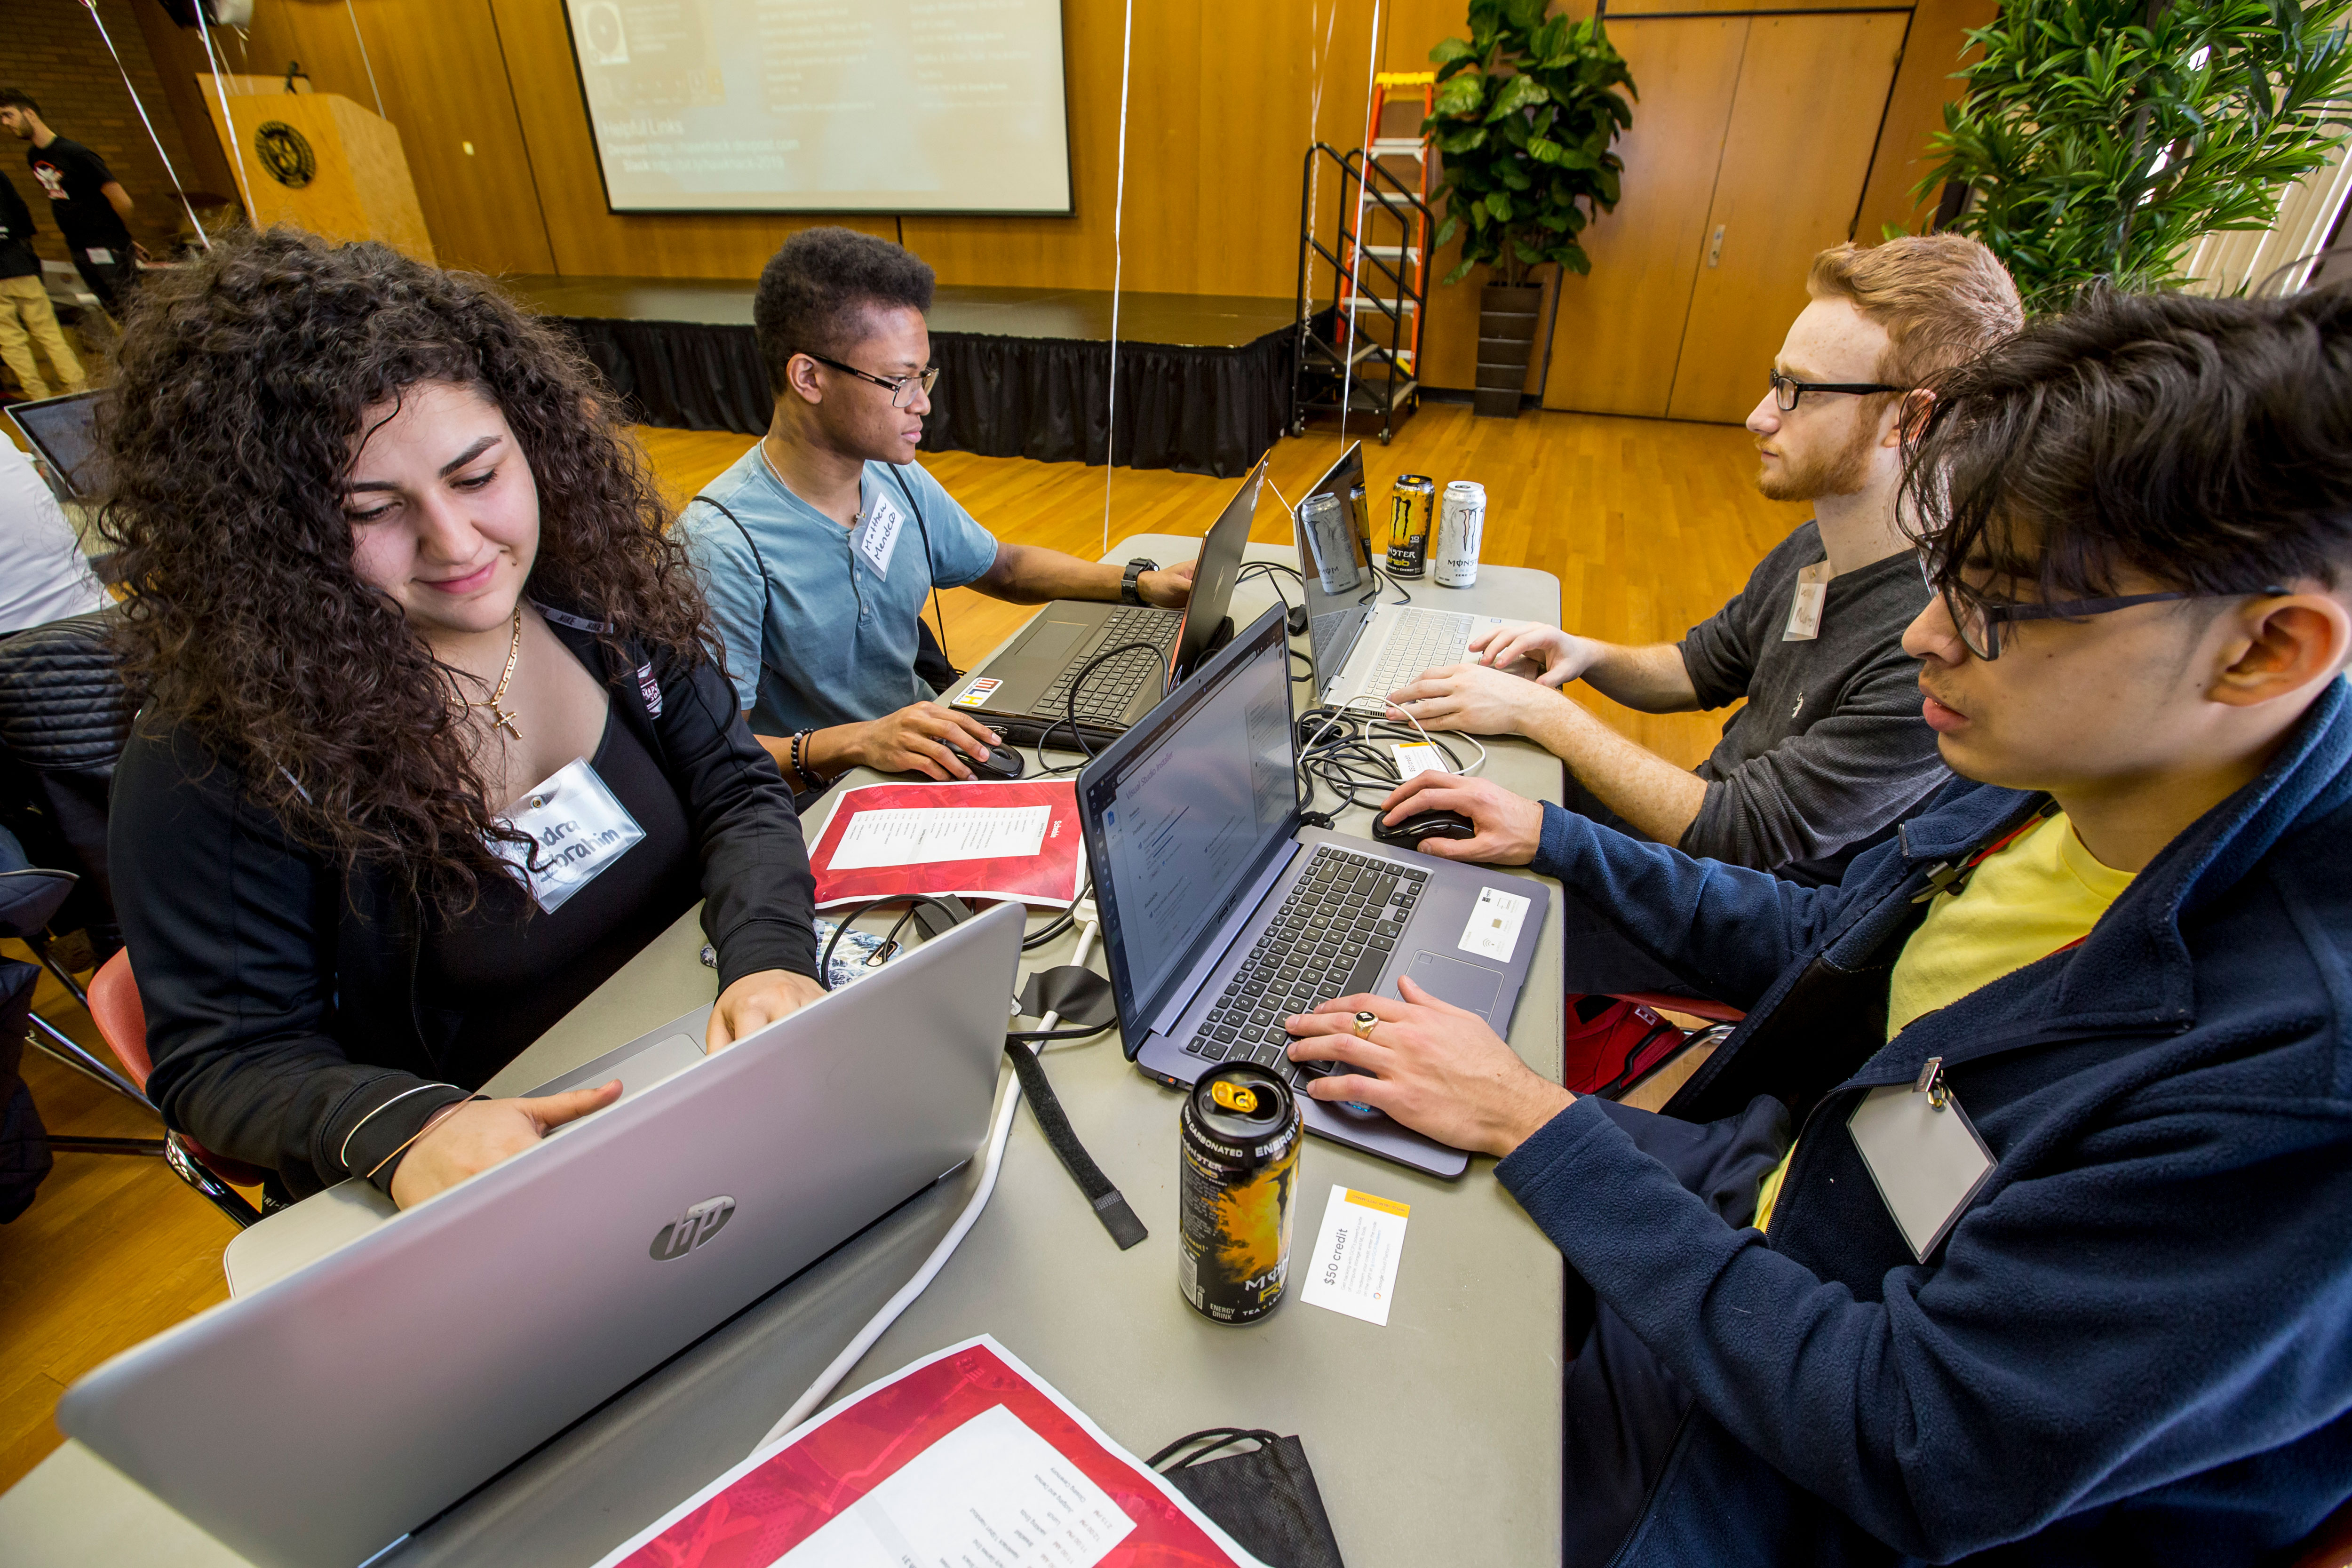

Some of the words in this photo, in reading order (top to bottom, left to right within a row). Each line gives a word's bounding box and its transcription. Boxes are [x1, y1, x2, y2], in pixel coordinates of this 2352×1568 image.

[865, 502, 887, 551] Matthew
[1387, 556, 1410, 566] ehab
[1388, 547, 1415, 558] NSTER
[961, 679, 1000, 705] MLH
[1126, 781, 1140, 799] Visual
[1141, 767, 1156, 785] Studio
[1156, 750, 1172, 770] Installer
[1132, 819, 1145, 836] Installed
[1144, 891, 1157, 908] Available
[1189, 1122, 1243, 1158] CARBONATED
[1255, 1122, 1296, 1158] ENERGY
[664, 1201, 726, 1256] hp
[1329, 1227, 1348, 1261] credit
[1343, 1264, 1351, 1282] hacking
[1352, 1226, 1361, 1243] powerful
[1322, 1262, 1340, 1286] $50
[1376, 1274, 1385, 1291] Google
[1210, 1303, 1235, 1314] ENERGY
[1212, 1310, 1232, 1320] DRINK
[1034, 1474, 1049, 1489] Demos
[1049, 1467, 1071, 1487] Ceremony
[1047, 1488, 1057, 1497] and
[1069, 1486, 1086, 1502] Closing
[1056, 1496, 1073, 1513] Judging
[969, 1508, 986, 1526] Handout
[1019, 1509, 1031, 1521] Ends
[1047, 1512, 1060, 1525] Lunch
[1093, 1510, 1102, 1518] PM
[1029, 1520, 1047, 1536] Hacking
[1079, 1519, 1088, 1528] PM
[1014, 1529, 1033, 1547] Breakfast
[1065, 1529, 1076, 1538] PM
[972, 1539, 981, 1550] End
[1052, 1541, 1063, 1550] AM
